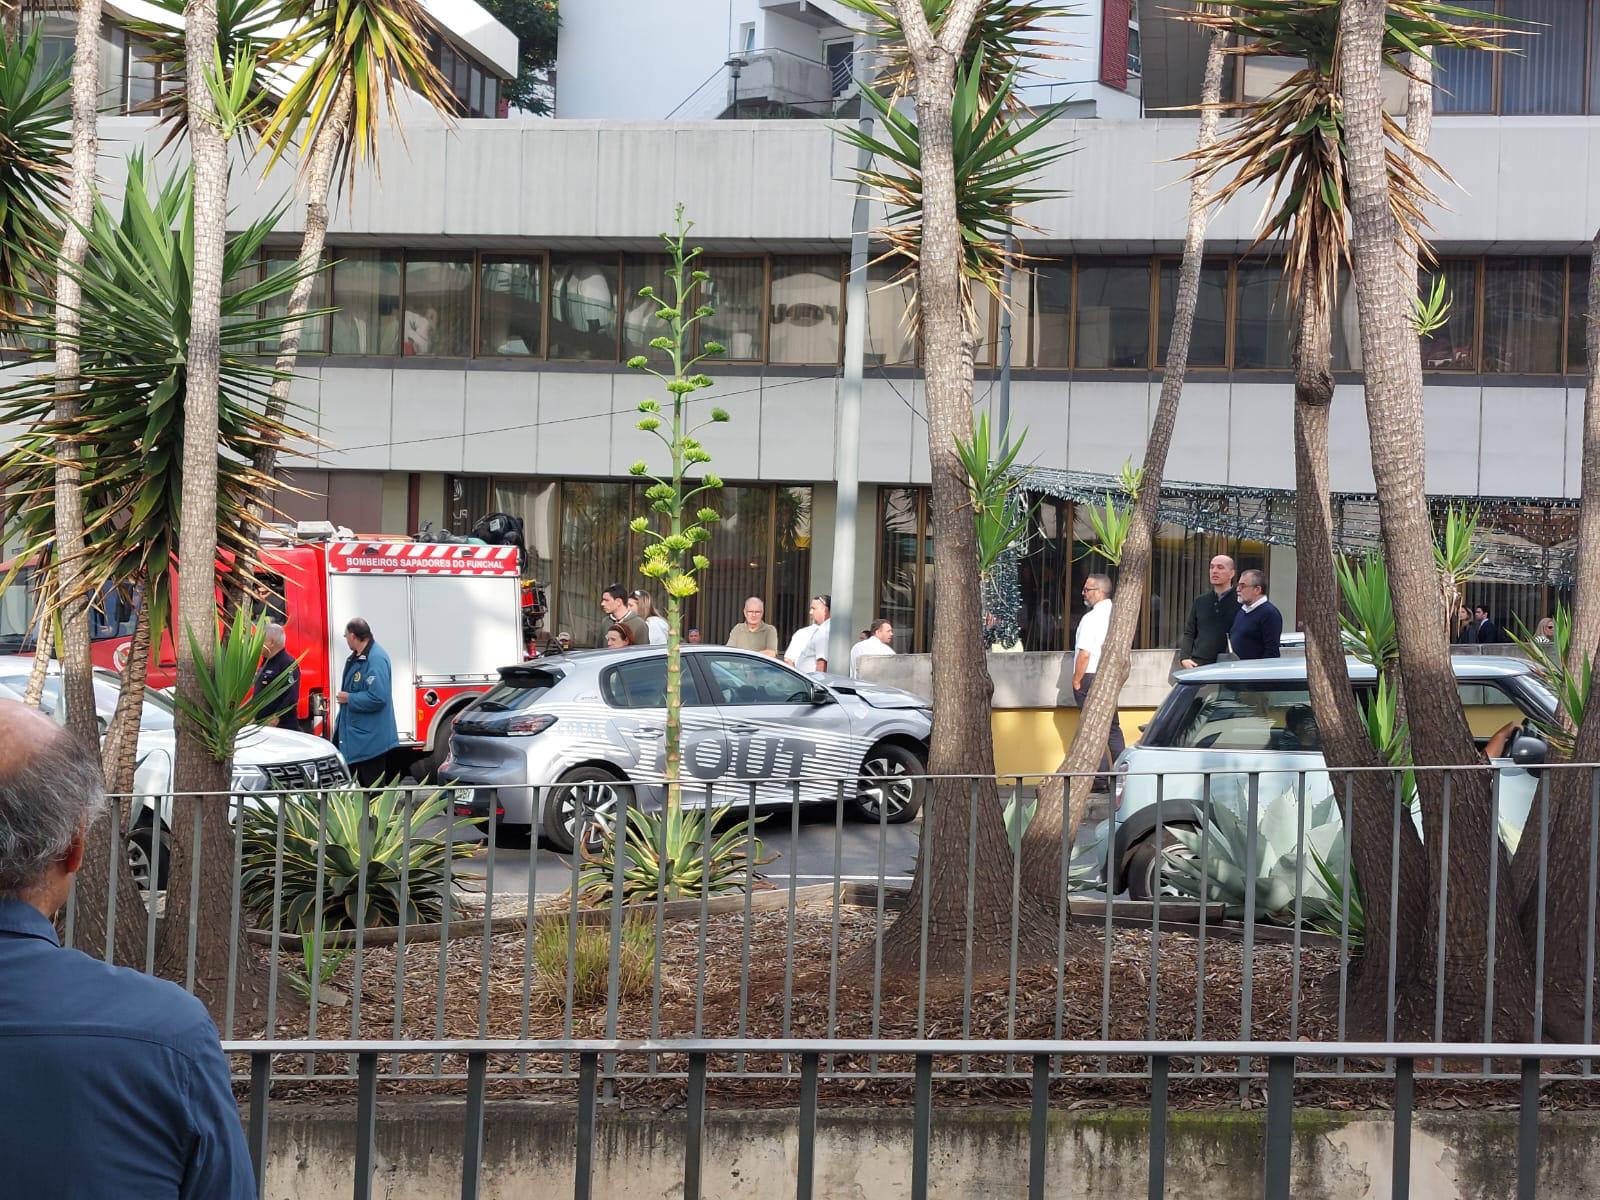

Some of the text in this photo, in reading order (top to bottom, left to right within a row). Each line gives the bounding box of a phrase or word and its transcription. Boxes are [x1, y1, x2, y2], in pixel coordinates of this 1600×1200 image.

[346, 557, 504, 569] BOMBEIROS SAPADORES DO FUNCHAL
